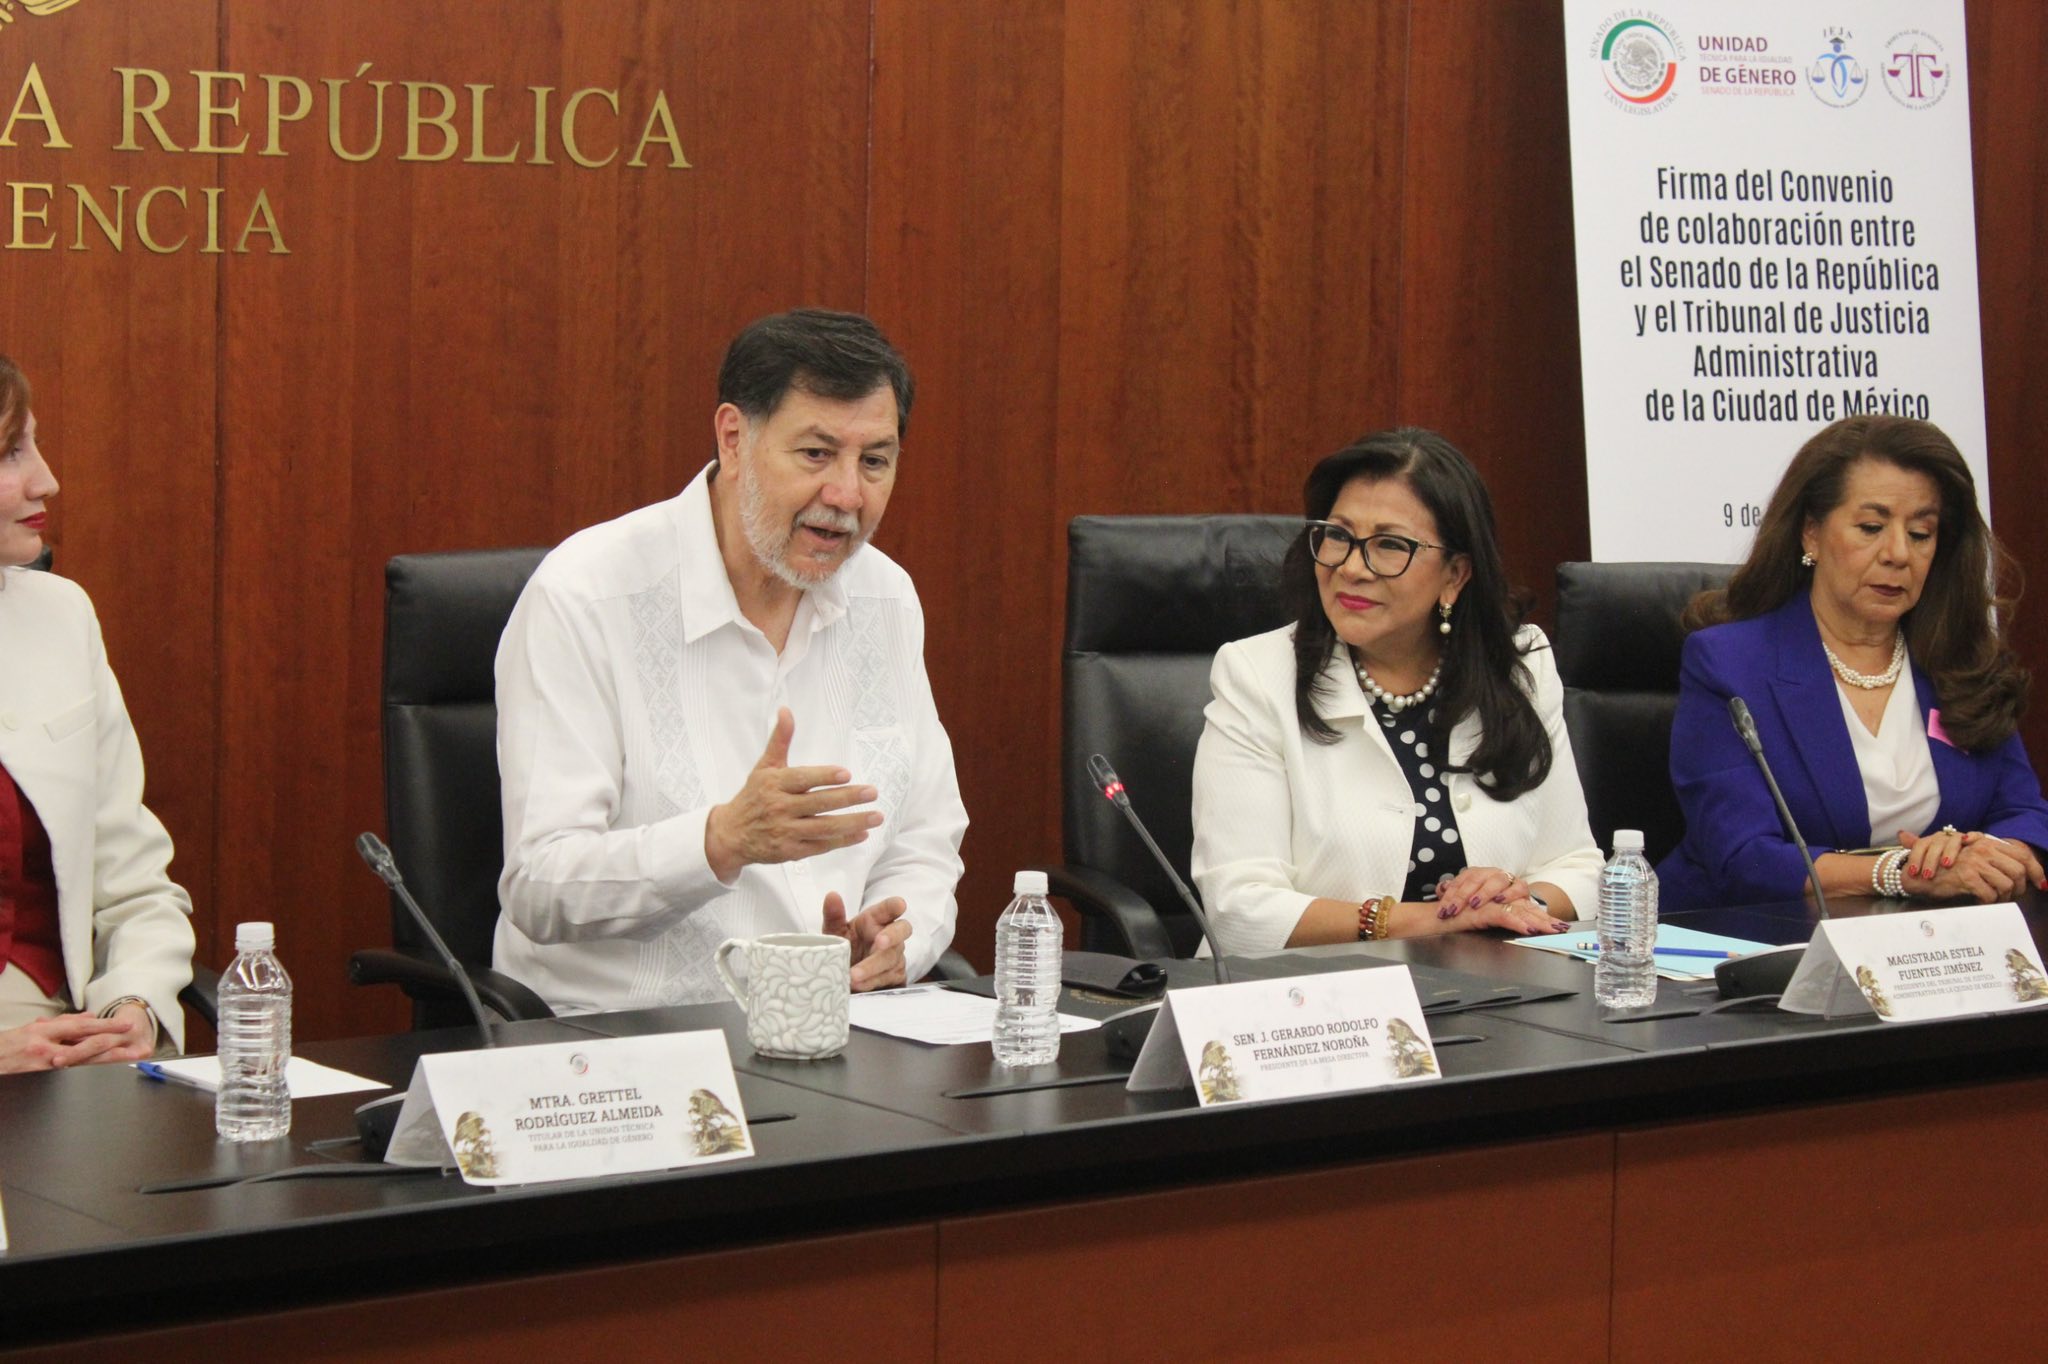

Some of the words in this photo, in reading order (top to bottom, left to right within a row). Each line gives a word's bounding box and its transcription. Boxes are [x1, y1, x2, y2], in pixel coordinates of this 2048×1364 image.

[1698, 35, 1768, 52] UNIDAD
[1700, 66, 1721, 82] DE
[1725, 64, 1797, 85] GÉNERO
[112, 61, 693, 169] REPÚBLICA
[1657, 166, 1728, 201] Firma
[1735, 169, 1773, 202] del
[1780, 170, 1894, 203] Convenio
[4, 181, 292, 254] ENCIA
[1640, 212, 1669, 244] de
[1677, 211, 1843, 247] colaboración
[1850, 214, 1916, 248] entre
[1620, 256, 1642, 288] el
[1650, 255, 1742, 290] Senado
[1749, 257, 1779, 290] de
[1786, 258, 1809, 290] la
[1817, 255, 1939, 294] República
[1634, 303, 1647, 337] y
[1655, 300, 1676, 333] el
[1683, 299, 1786, 334] Tribunal
[1793, 301, 1823, 335] de
[1830, 300, 1930, 335] Justicia
[1693, 344, 1878, 378] Administrativa
[1645, 388, 1674, 422] de
[1683, 389, 1705, 422] la
[1712, 388, 1798, 422] Ciudad
[1806, 389, 1836, 422] de
[1843, 386, 1930, 421] México
[1723, 503, 1734, 528] 9
[1741, 503, 1761, 528] de
[1887, 950, 1949, 966] MAGISTRADA
[1950, 946, 1985, 960] ESTELA
[1898, 966, 1942, 981] FUENTES
[1944, 961, 1984, 976] JIMÉNEZ
[1233, 1033, 1258, 1046] SEN.
[1261, 1032, 1269, 1043] J.
[1271, 1024, 1325, 1041] GERARDO
[1327, 1017, 1379, 1034] RODOLFO
[1253, 1042, 1320, 1061] FERNÁNDEZ
[1322, 1034, 1369, 1052] NOROÑA
[528, 1094, 575, 1110] MTRA.
[578, 1087, 642, 1105] GRETTEL
[515, 1110, 598, 1131] RODRÍGUEZ
[601, 1104, 664, 1122] ALMEIDA
[528, 1131, 562, 1143] TITULAR
[564, 1130, 575, 1139] DE
[577, 1129, 587, 1138] LA
[589, 1125, 620, 1136] UNIDAD
[533, 1143, 554, 1152] PARA
[556, 1141, 567, 1150] LA
[568, 1137, 608, 1150] IGUALDAD
[609, 1135, 621, 1145] DE
